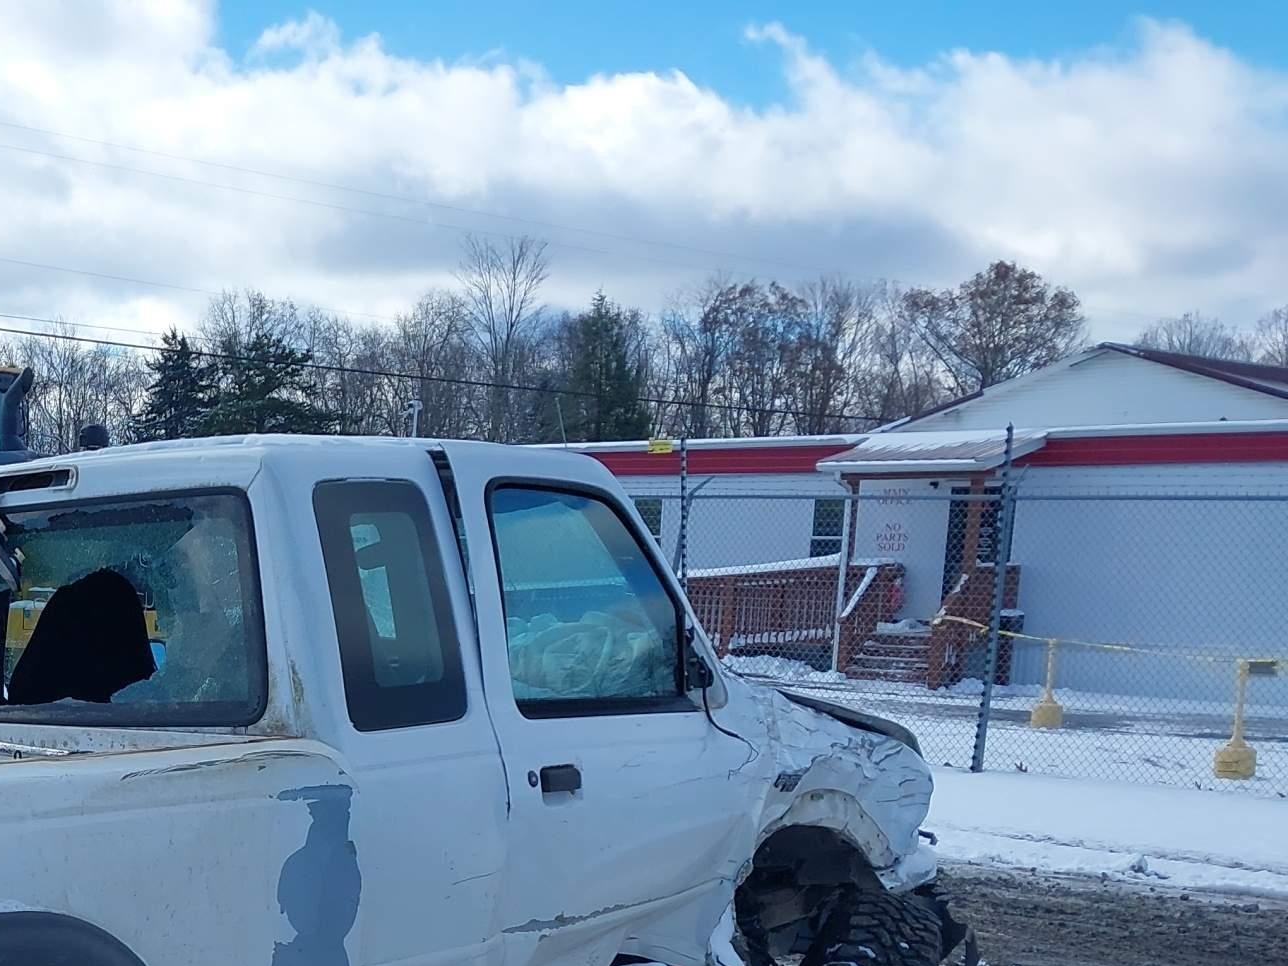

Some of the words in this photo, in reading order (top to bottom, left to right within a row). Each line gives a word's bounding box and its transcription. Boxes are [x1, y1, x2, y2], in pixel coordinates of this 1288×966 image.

[885, 523, 902, 532] NO
[876, 532, 910, 542] PARTS
[877, 542, 906, 552] SOLD
